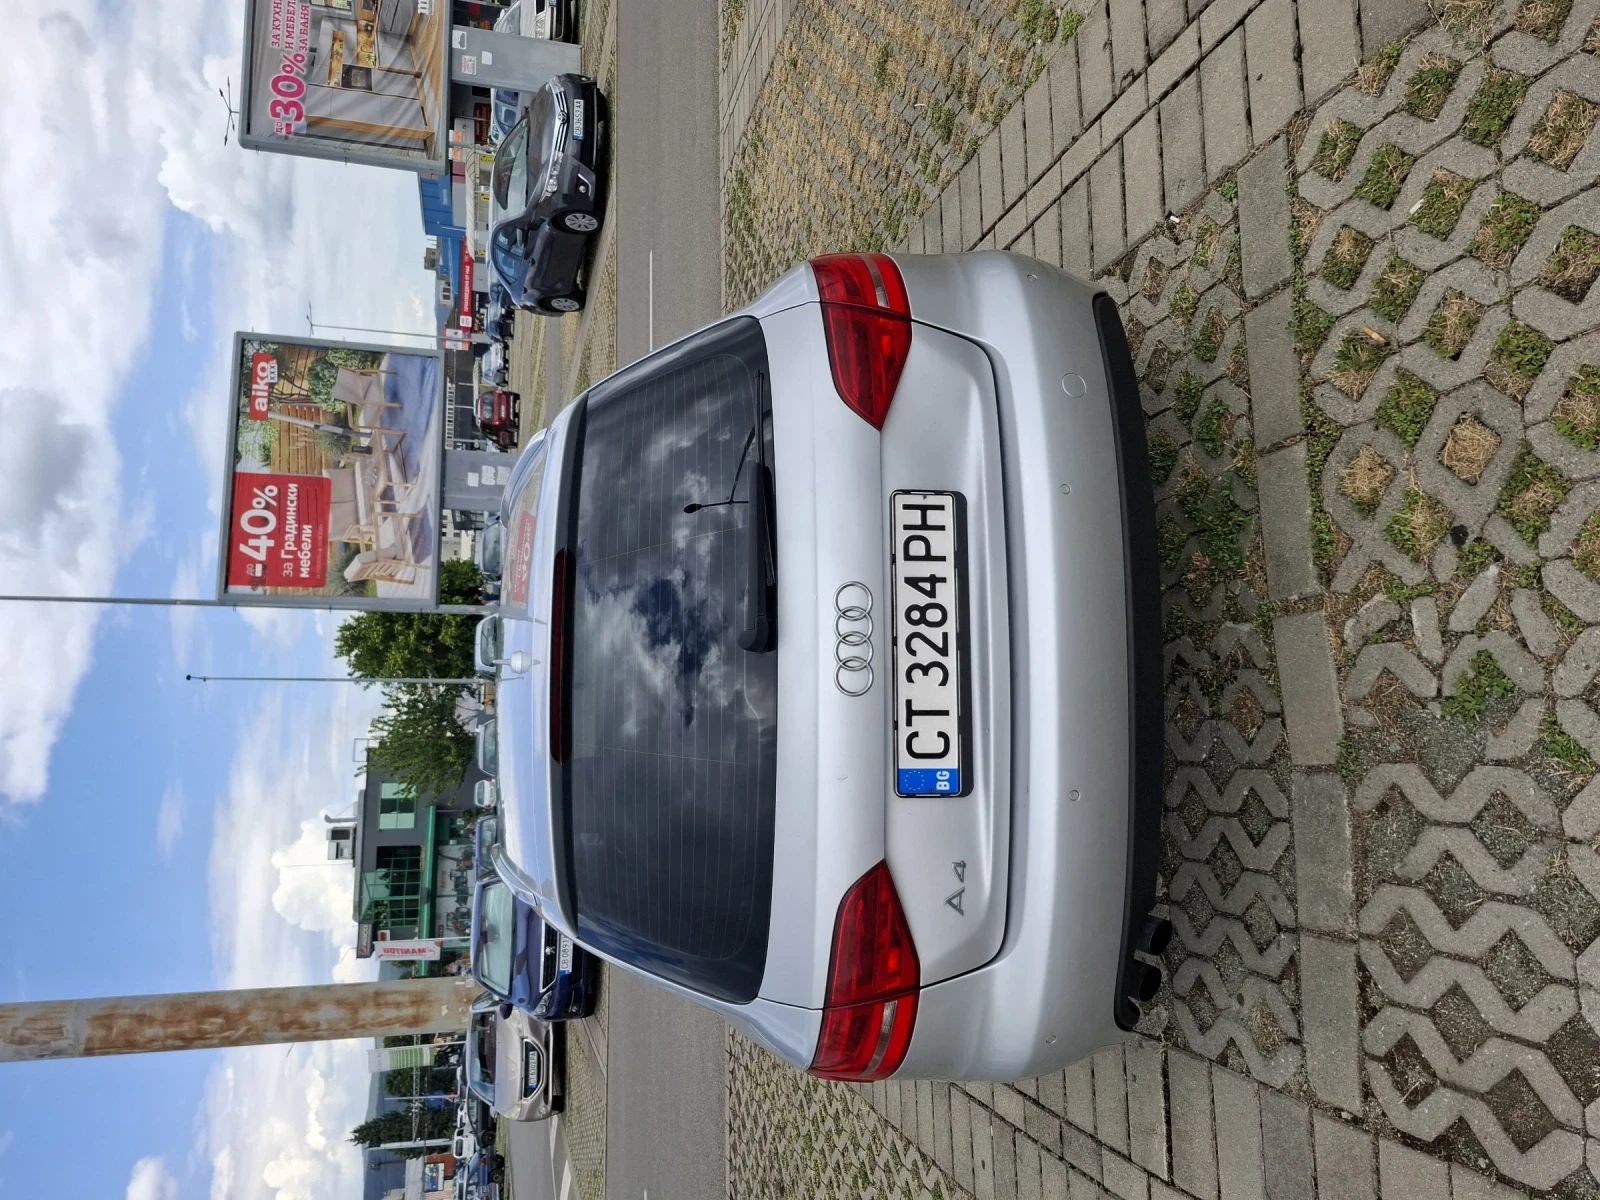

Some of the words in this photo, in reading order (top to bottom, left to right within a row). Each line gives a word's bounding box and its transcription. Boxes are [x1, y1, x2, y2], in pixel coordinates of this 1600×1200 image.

[271, 34, 280, 47] ЗА
[286, 0, 296, 39] МЕБЕЛ
[300, 4, 310, 36] БАНЯ
[285, 41, 294, 50] И
[299, 38, 308, 52] ЗА
[270, 53, 306, 135] -30%
[252, 362, 269, 412] aiko
[239, 485, 278, 576] -40%
[281, 483, 298, 558] Градински
[902, 504, 946, 562] PH
[246, 564, 254, 576] до
[282, 562, 293, 577] за
[298, 524, 312, 578] мебели
[904, 574, 948, 686] 3284
[906, 700, 950, 760] CT
[936, 770, 950, 790] BG
[944, 860, 966, 916] A4
